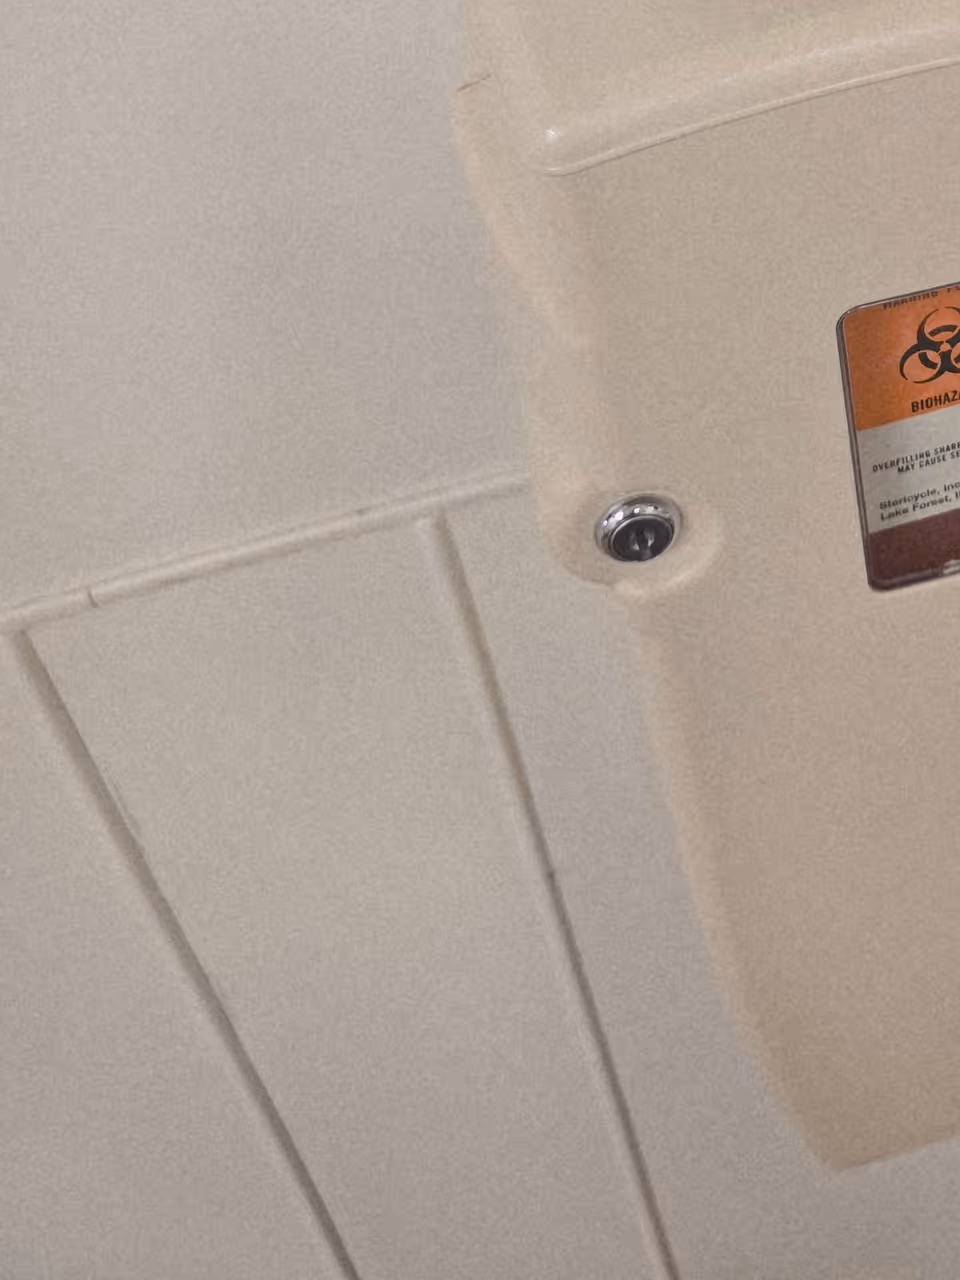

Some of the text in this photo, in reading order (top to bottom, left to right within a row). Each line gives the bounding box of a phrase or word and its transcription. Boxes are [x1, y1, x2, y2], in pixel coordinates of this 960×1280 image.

[872, 450, 931, 473] OVERFILLING
[897, 463, 915, 474] MAY
[919, 454, 947, 468] CAUSE
